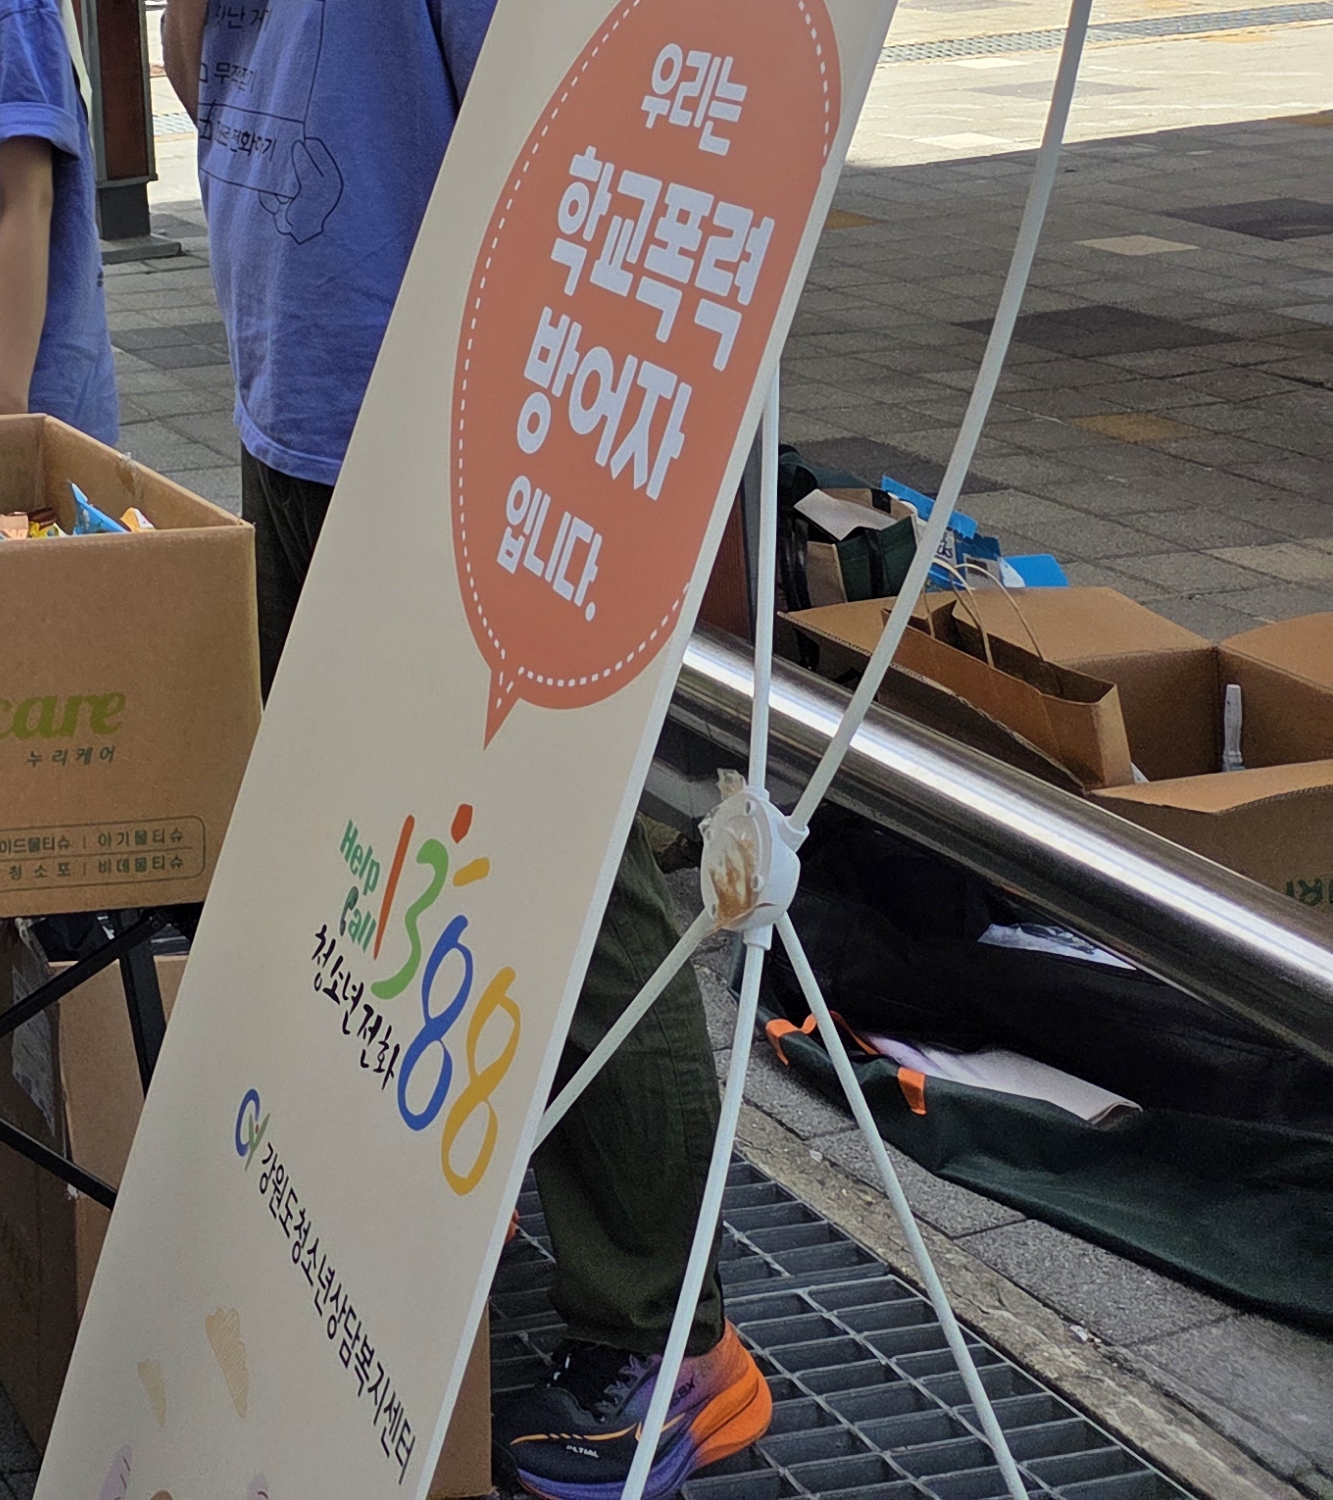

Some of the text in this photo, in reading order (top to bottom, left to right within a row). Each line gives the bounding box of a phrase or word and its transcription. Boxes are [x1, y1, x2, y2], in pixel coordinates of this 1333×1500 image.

[641, 42, 749, 156] 우리는
[550, 145, 775, 372] 학교폭력
[516, 305, 693, 501] 방어자
[496, 474, 604, 622] 입니다.
[340, 819, 380, 896] Help
[311, 924, 401, 1090] 청소년전화
[374, 814, 521, 1197] 1388
[259, 1142, 416, 1486] 강원도청소년상담복지센터
